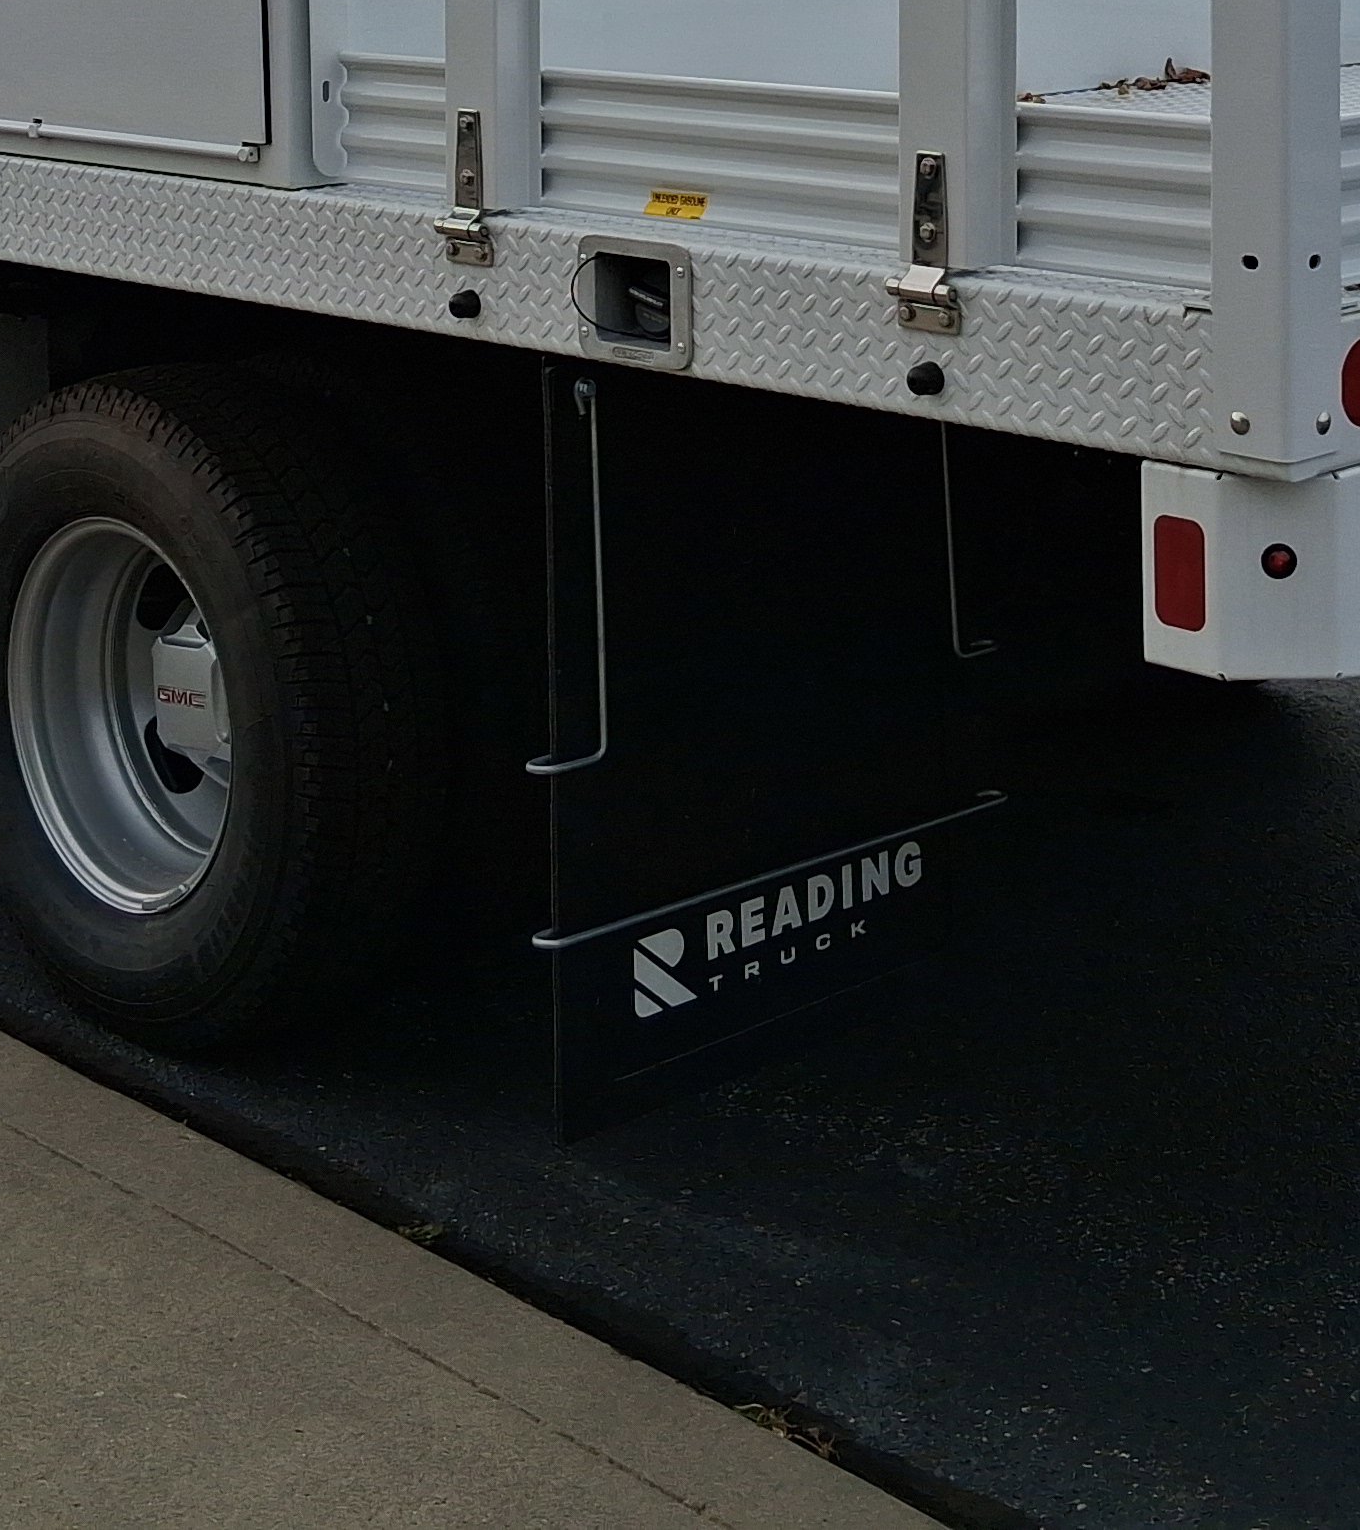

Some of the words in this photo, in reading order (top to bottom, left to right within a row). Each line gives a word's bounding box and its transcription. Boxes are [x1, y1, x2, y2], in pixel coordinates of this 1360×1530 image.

[157, 685, 207, 709] GMC
[706, 841, 924, 961] READING
[708, 919, 867, 992] TRUCK
